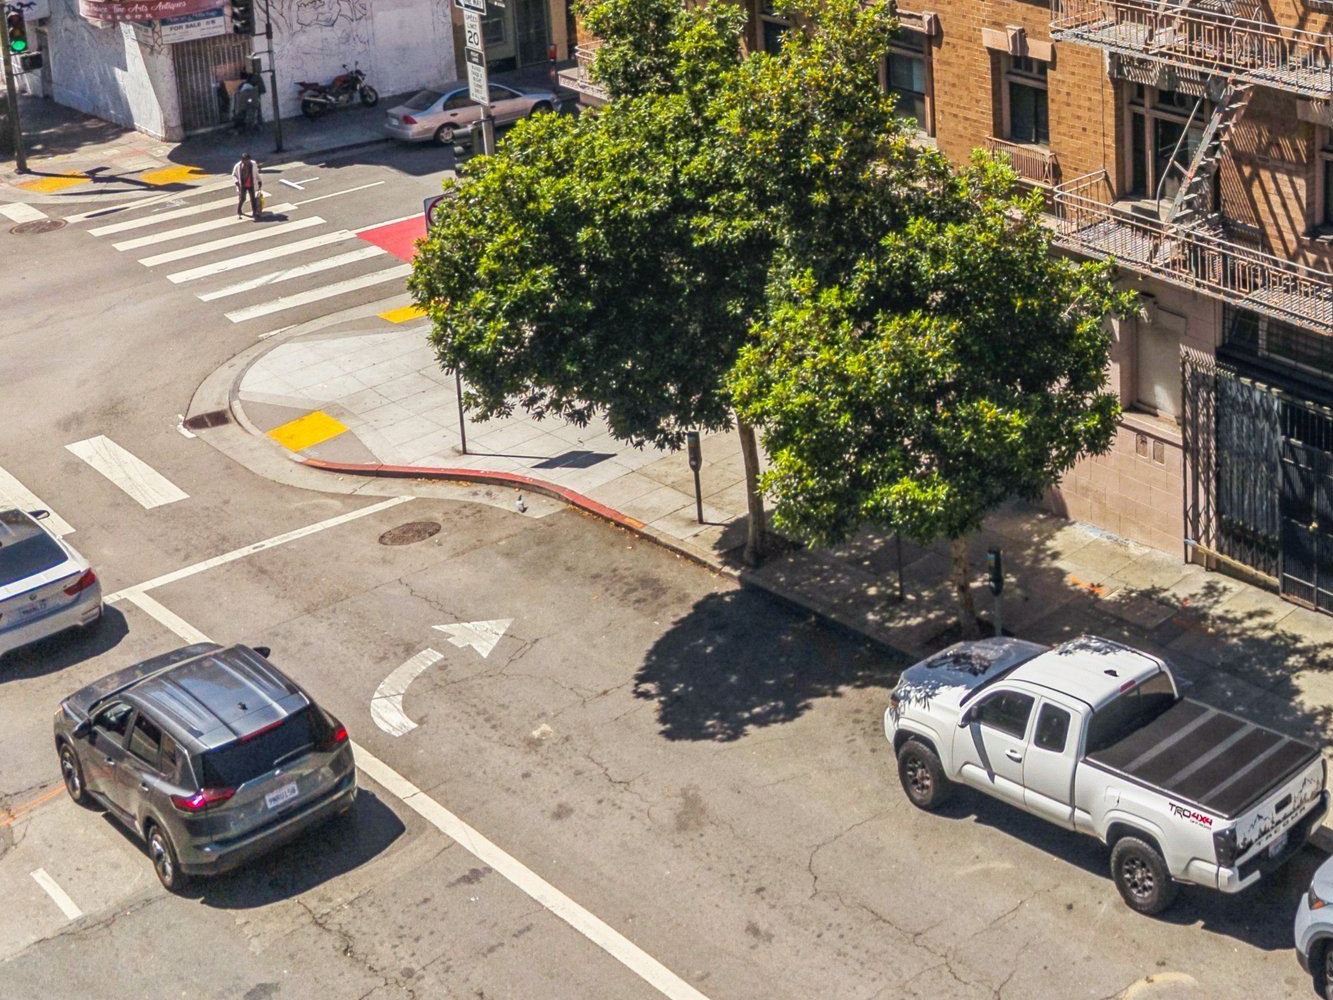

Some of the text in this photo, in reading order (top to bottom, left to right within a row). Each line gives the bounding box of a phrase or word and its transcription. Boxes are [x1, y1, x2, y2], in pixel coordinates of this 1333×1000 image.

[128, 3, 148, 13] Arts
[151, 1, 186, 11] Antiques
[467, 30, 479, 46] 20
[1256, 806, 1305, 846] TACOMA
